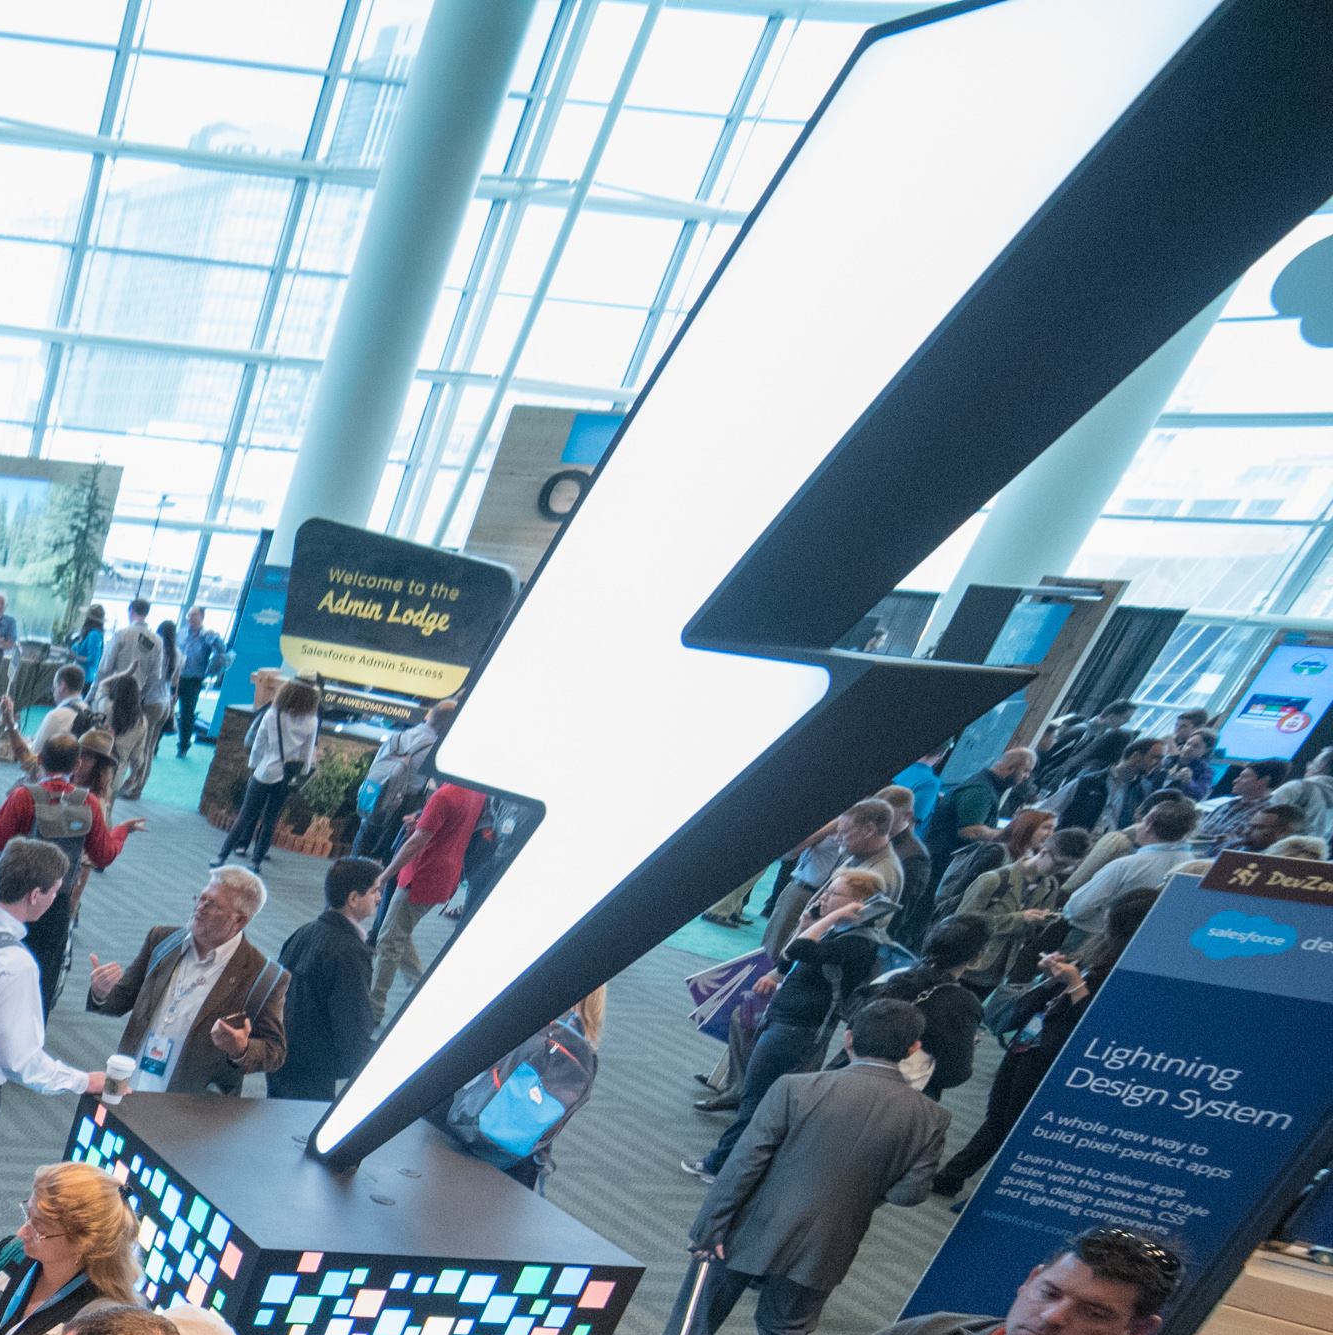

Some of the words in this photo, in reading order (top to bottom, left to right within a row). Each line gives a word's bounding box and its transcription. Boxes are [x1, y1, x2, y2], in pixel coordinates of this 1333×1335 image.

[328, 568, 403, 593] Welcome
[408, 580, 426, 596] to
[431, 582, 460, 601] the
[318, 590, 383, 621] Admin
[386, 600, 450, 636] Lodge
[301, 644, 356, 663] Salesforce
[358, 655, 395, 671] Admin
[398, 661, 444, 680] Success
[325, 694, 336, 704] OF
[337, 696, 411, 719] #AWESOMEADMIN
[1207, 927, 1286, 946] salesforce
[1301, 937, 1333, 953] de
[1083, 1037, 1243, 1091] Lightning
[1065, 1067, 1169, 1107] Design
[1172, 1089, 1293, 1131] System
[1032, 1125, 1076, 1145] build
[1075, 1134, 1186, 1170] pixel-perfect
[1185, 1160, 1233, 1180] apps
[1040, 1111, 1054, 1123] A
[1058, 1115, 1109, 1135] whole
[1111, 1126, 1150, 1143] new
[1151, 1136, 1187, 1154] way
[1189, 1143, 1209, 1157] to
[1009, 1162, 1045, 1179] faster
[1047, 1171, 1076, 1186] with
[1077, 1178, 1103, 1192] this
[1104, 1186, 1135, 1199] new
[1135, 1192, 1158, 1205] set
[1158, 1196, 1175, 1209] of
[1176, 1202, 1211, 1218] style
[1016, 1150, 1053, 1168] Learn
[1055, 1160, 1086, 1174] how
[1087, 1166, 1101, 1178] to
[1102, 1171, 1150, 1189] deliver
[1149, 1182, 1186, 1198] apps
[994, 1186, 1022, 1199] and
[1022, 1193, 1083, 1216] Lightning
[1083, 1208, 1170, 1235] components
[1000, 1174, 1046, 1194] guides,
[1049, 1186, 1094, 1204] design
[1094, 1197, 1154, 1219] patterns,
[1157, 1211, 1187, 1225] CSS
